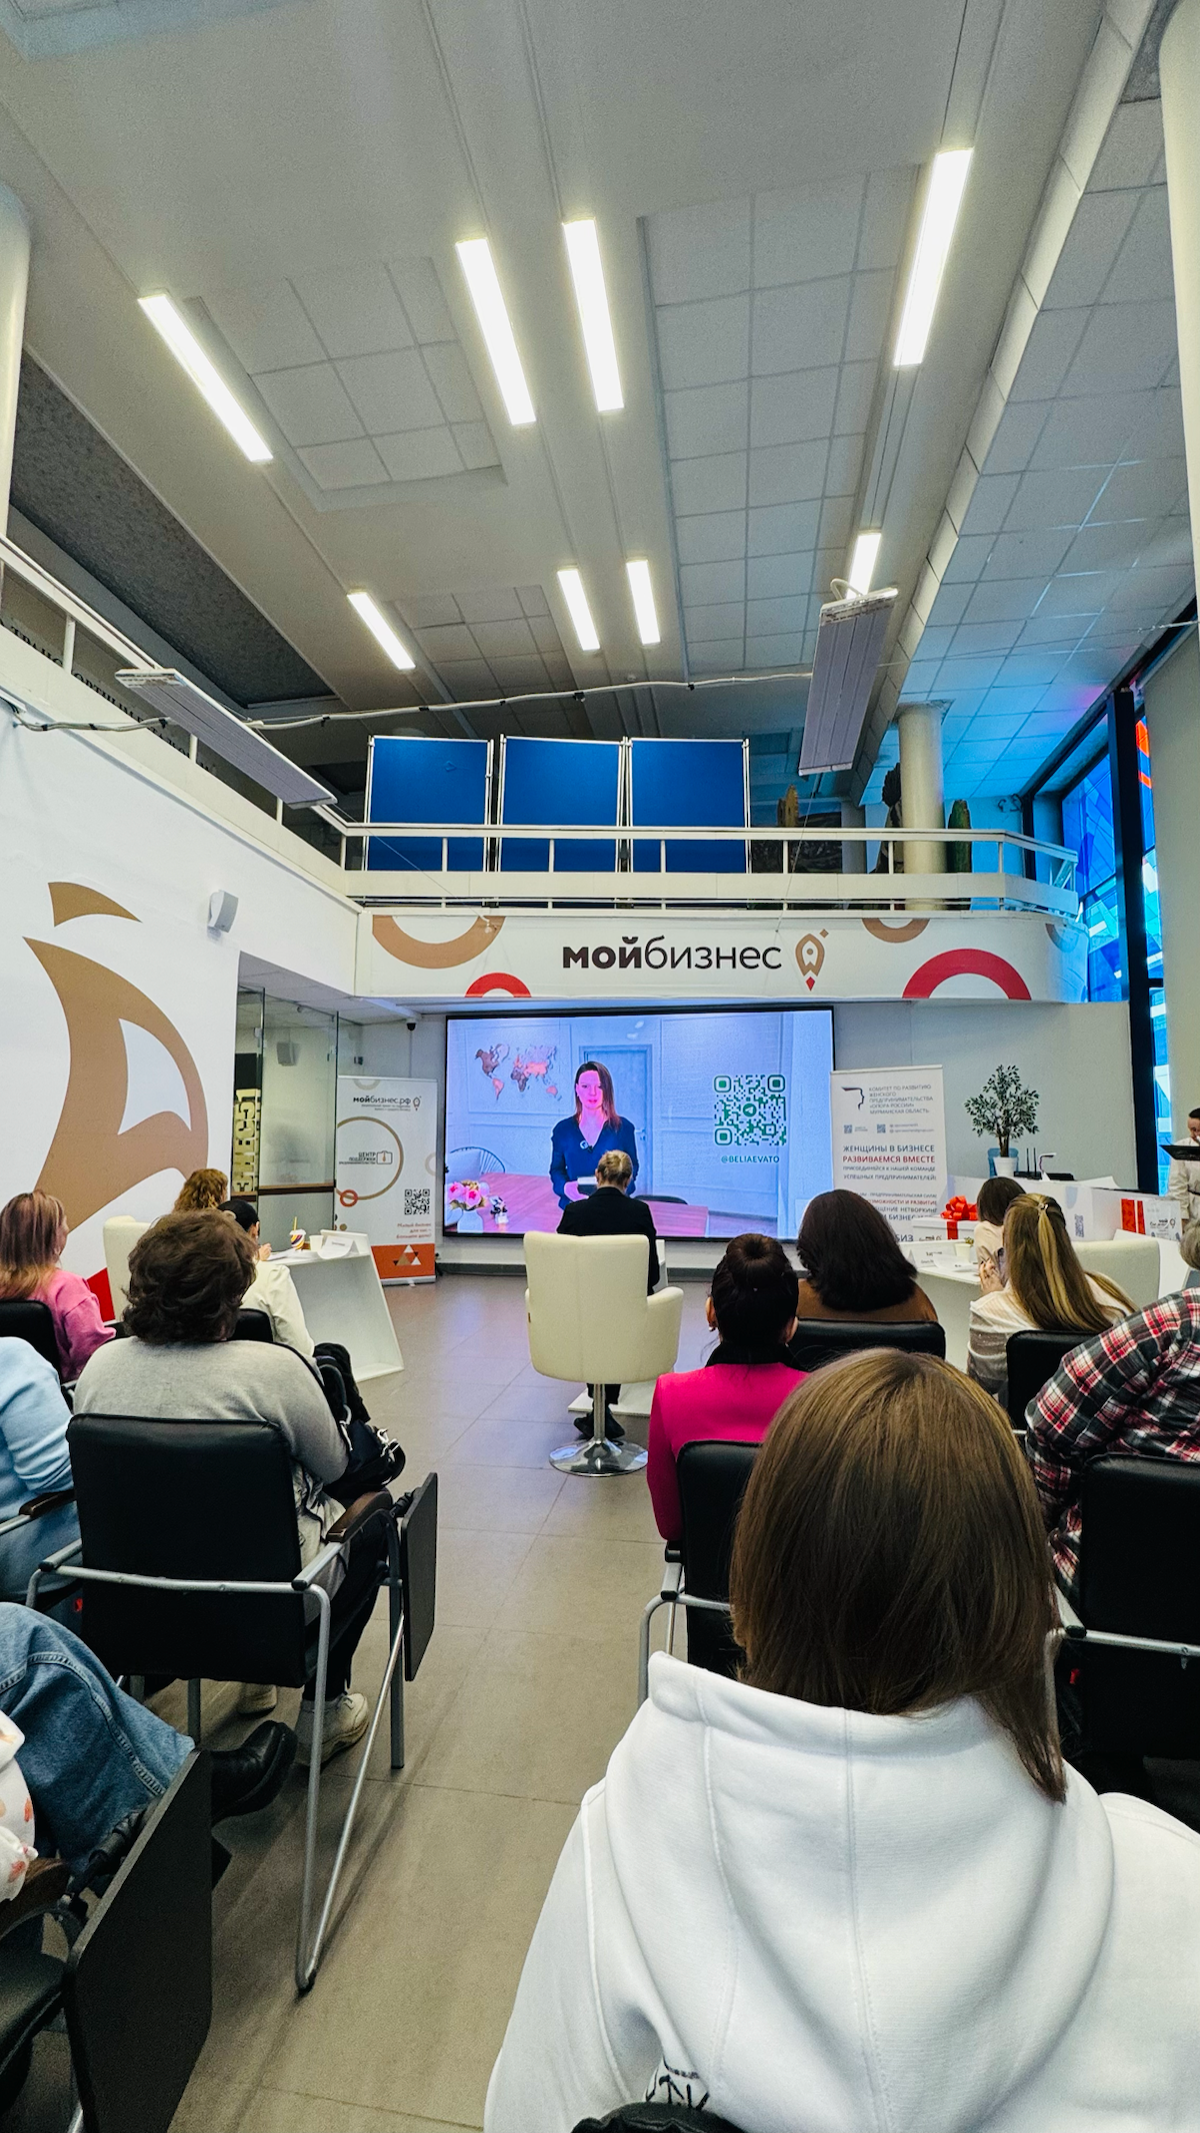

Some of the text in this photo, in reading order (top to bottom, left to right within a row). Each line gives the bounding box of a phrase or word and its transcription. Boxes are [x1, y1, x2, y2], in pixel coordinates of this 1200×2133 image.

[562, 935, 782, 969] мойбизнес
[353, 1095, 411, 1105] мойбизнес.рф
[843, 1145, 887, 1153] ЖЕНЩИНЫ
[897, 1144, 935, 1152] БИЗНЕСЕ
[721, 1155, 780, 1163] @BELIAEVATO
[842, 1155, 935, 1163] РАЗВИВАЕМСЯ ВМЕСТЕ
